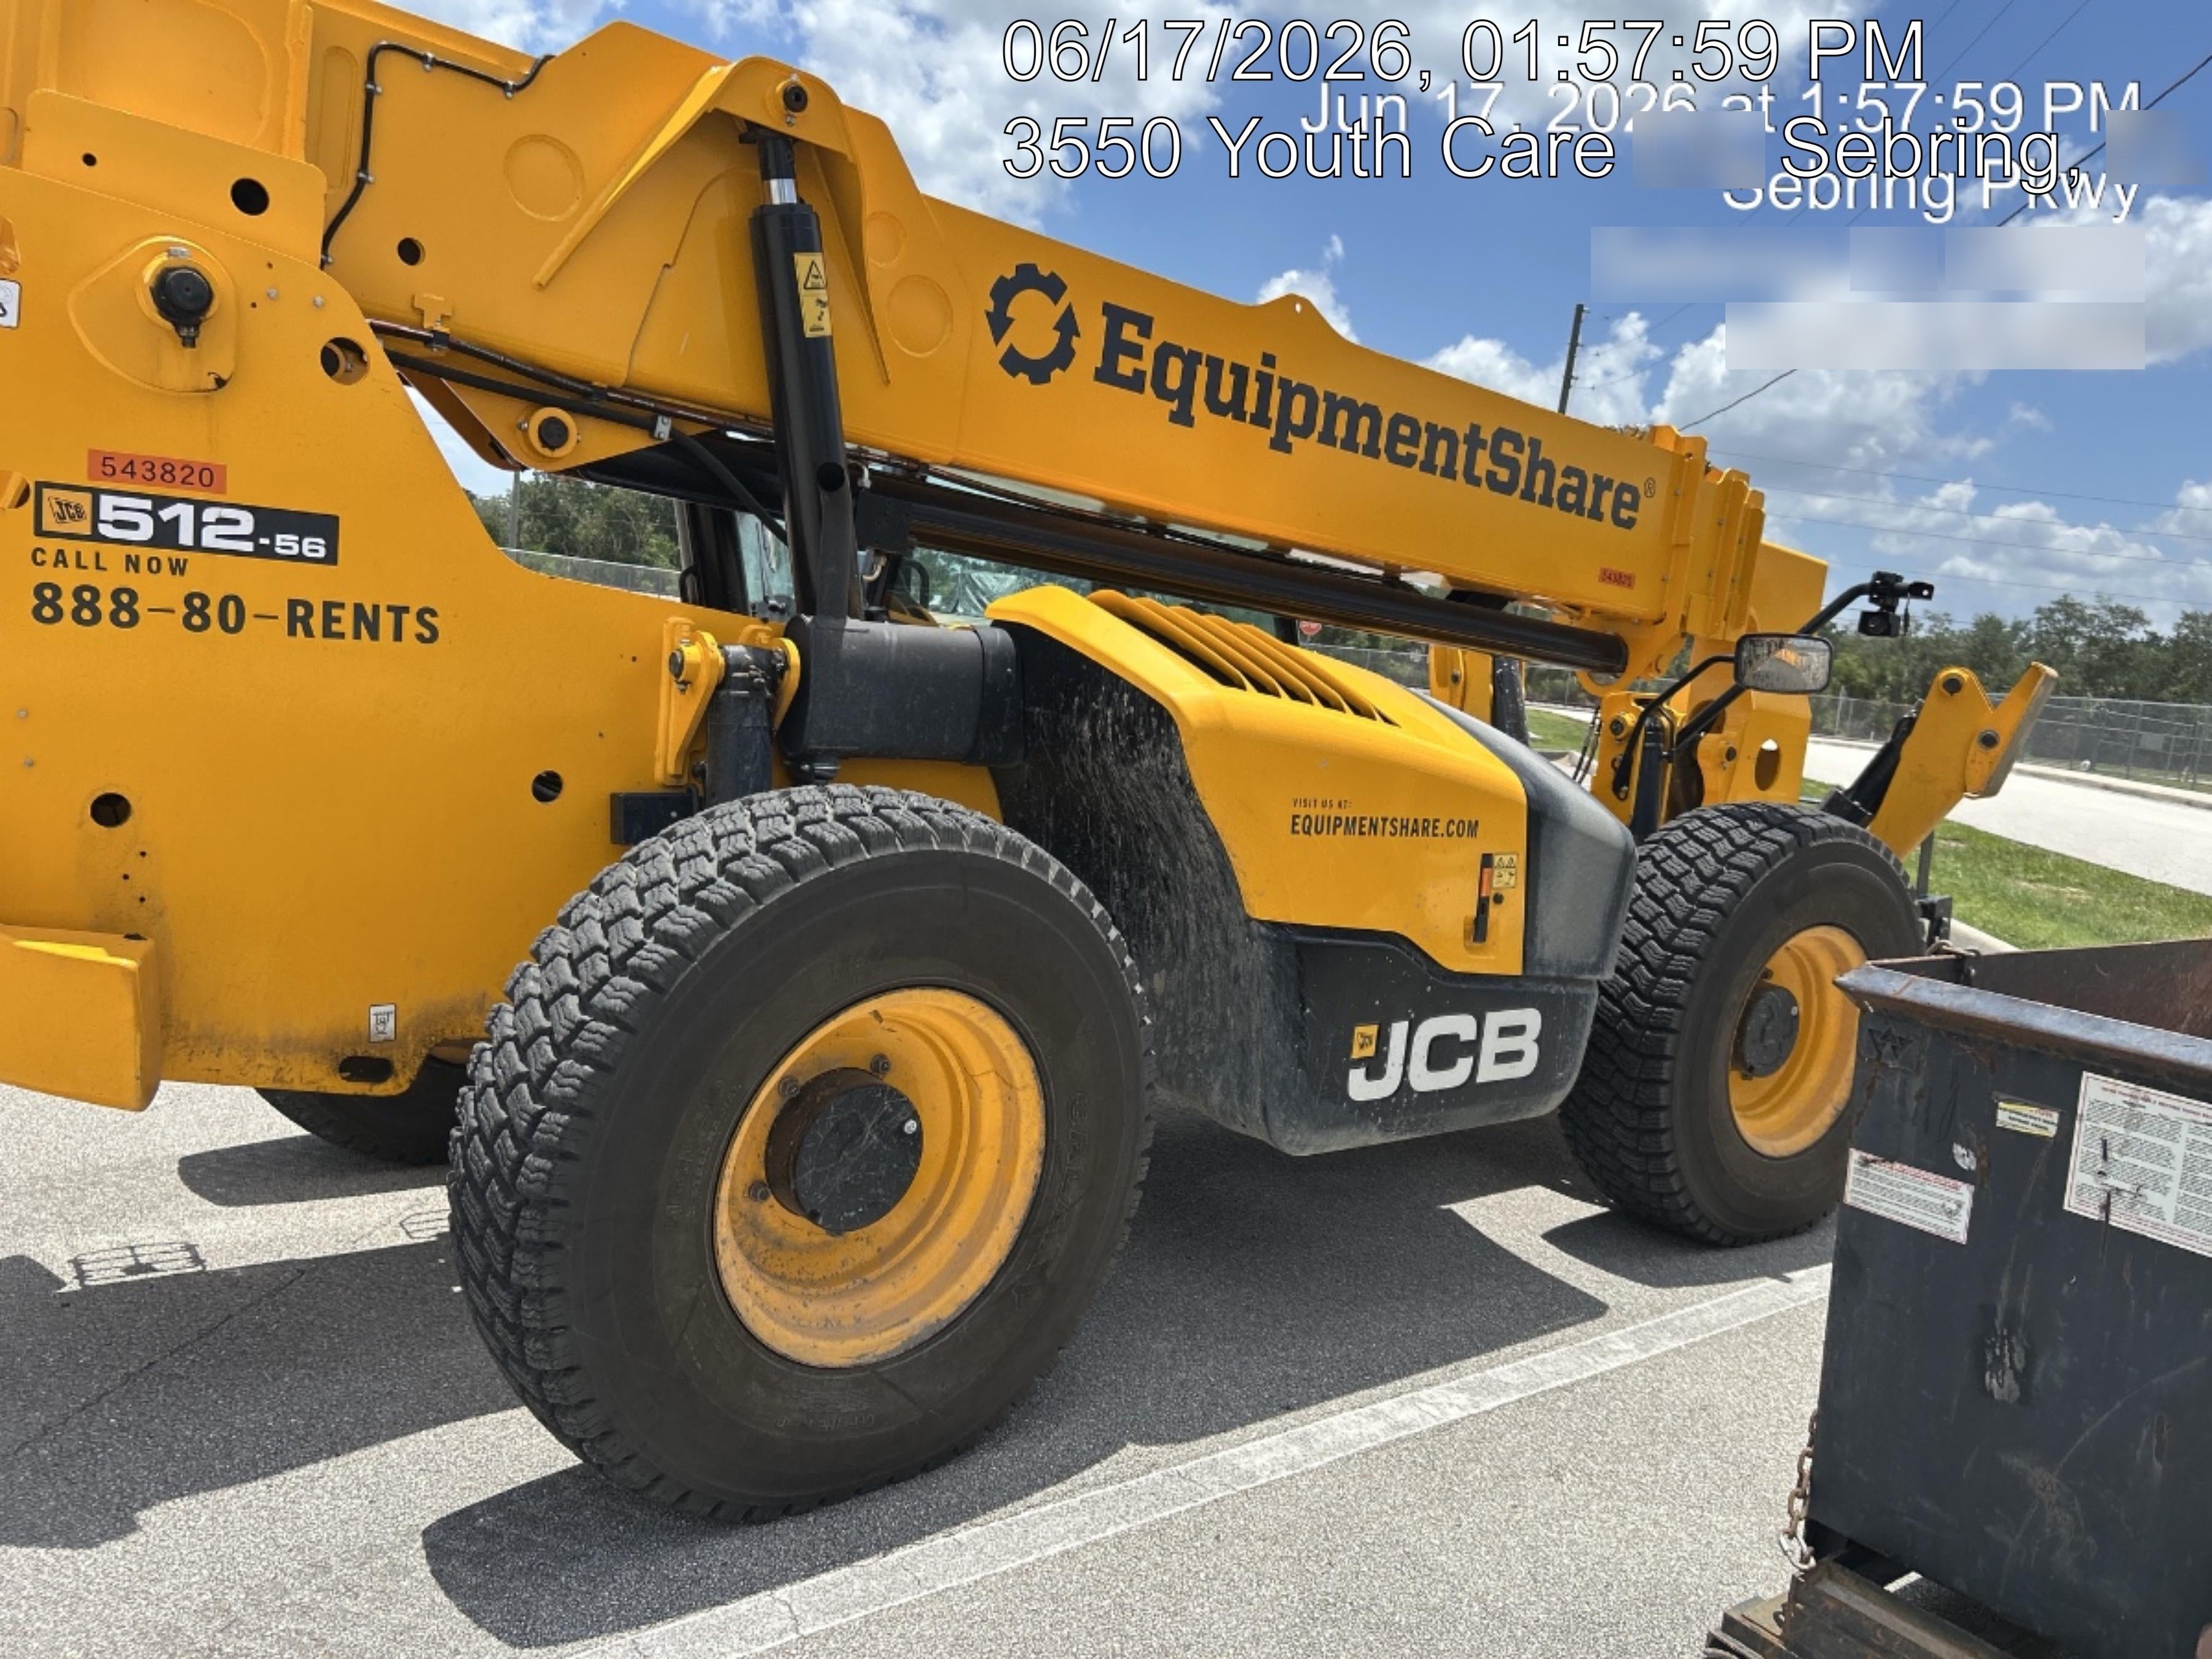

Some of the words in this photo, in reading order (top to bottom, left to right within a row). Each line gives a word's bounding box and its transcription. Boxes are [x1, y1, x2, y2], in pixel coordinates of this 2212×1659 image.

[100, 456, 215, 488] 543820
[97, 493, 327, 559] 512-56
[31, 546, 108, 572] CALL
[125, 554, 189, 576] NOW
[31, 581, 440, 645] 888-80-RENTS
[1292, 798, 1317, 809] VISIT
[1322, 798, 1333, 809] US
[1290, 814, 1480, 839] EQUIPMENTSHARE.COM
[1347, 1008, 1542, 1102] JCB
